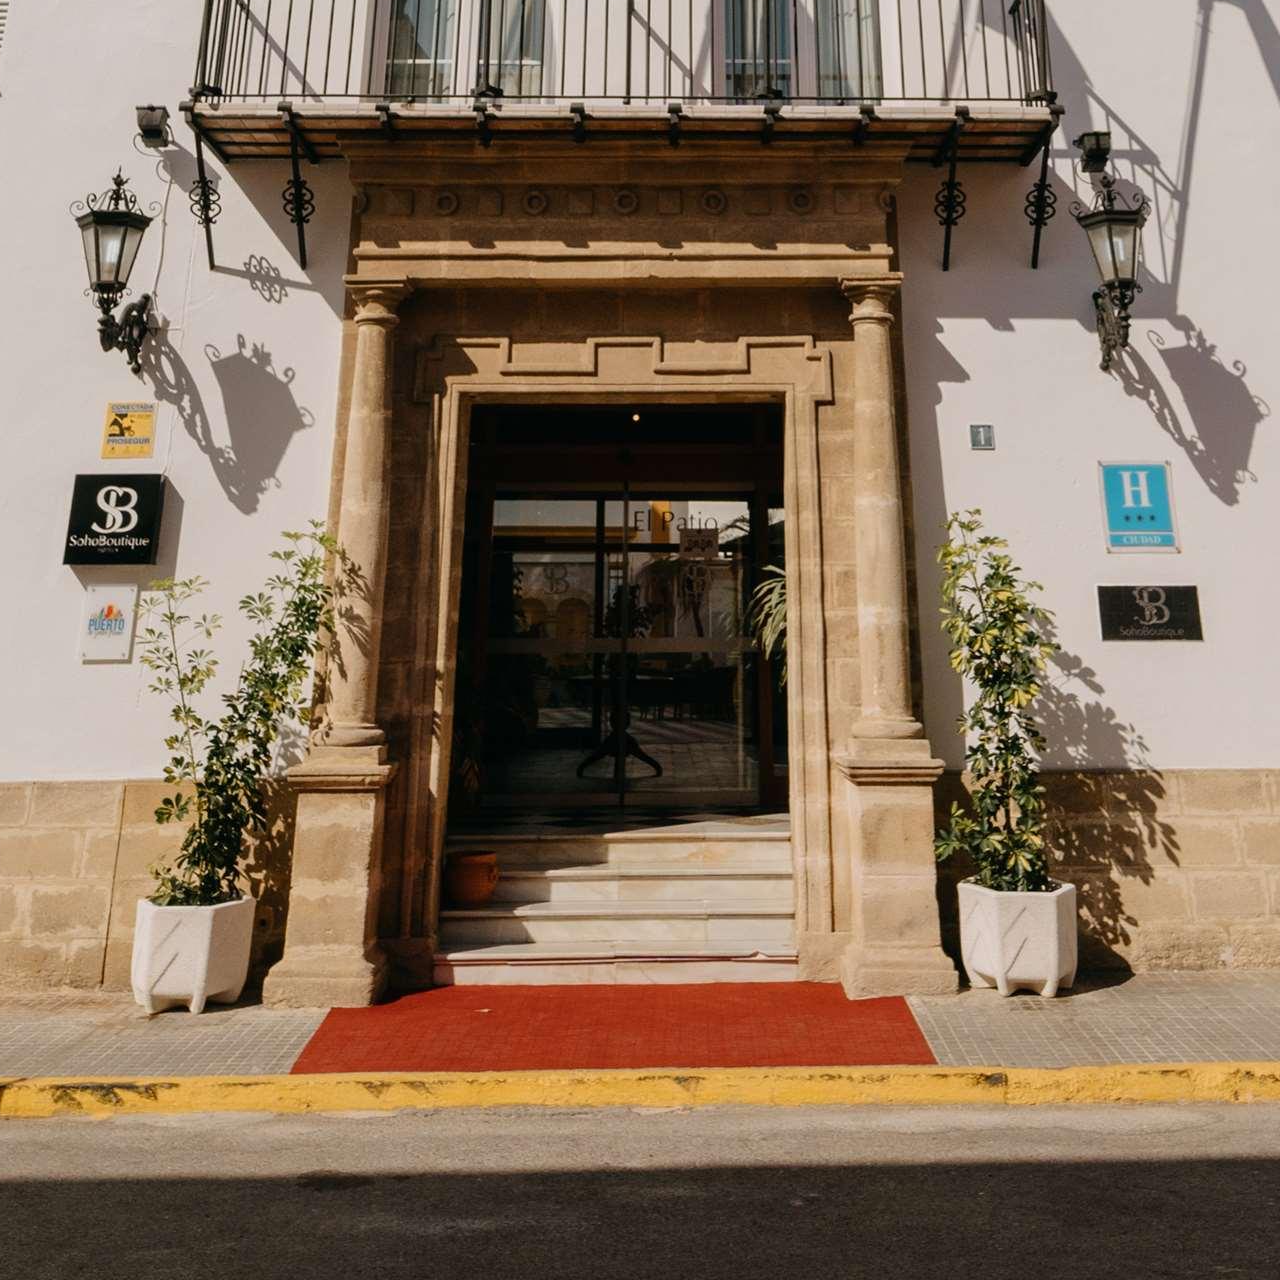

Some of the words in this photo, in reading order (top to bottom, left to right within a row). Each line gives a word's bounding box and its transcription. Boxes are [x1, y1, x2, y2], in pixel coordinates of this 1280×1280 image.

[107, 438, 150, 446] PROSEGUR
[977, 427, 985, 445] 1
[1119, 471, 1152, 507] H
[91, 485, 139, 533] SB
[634, 510, 652, 531] El
[662, 510, 718, 531] Patio
[69, 534, 151, 550] SohoBoutique
[1123, 535, 1161, 545] CIUDAD
[88, 617, 125, 631] PUERTO
